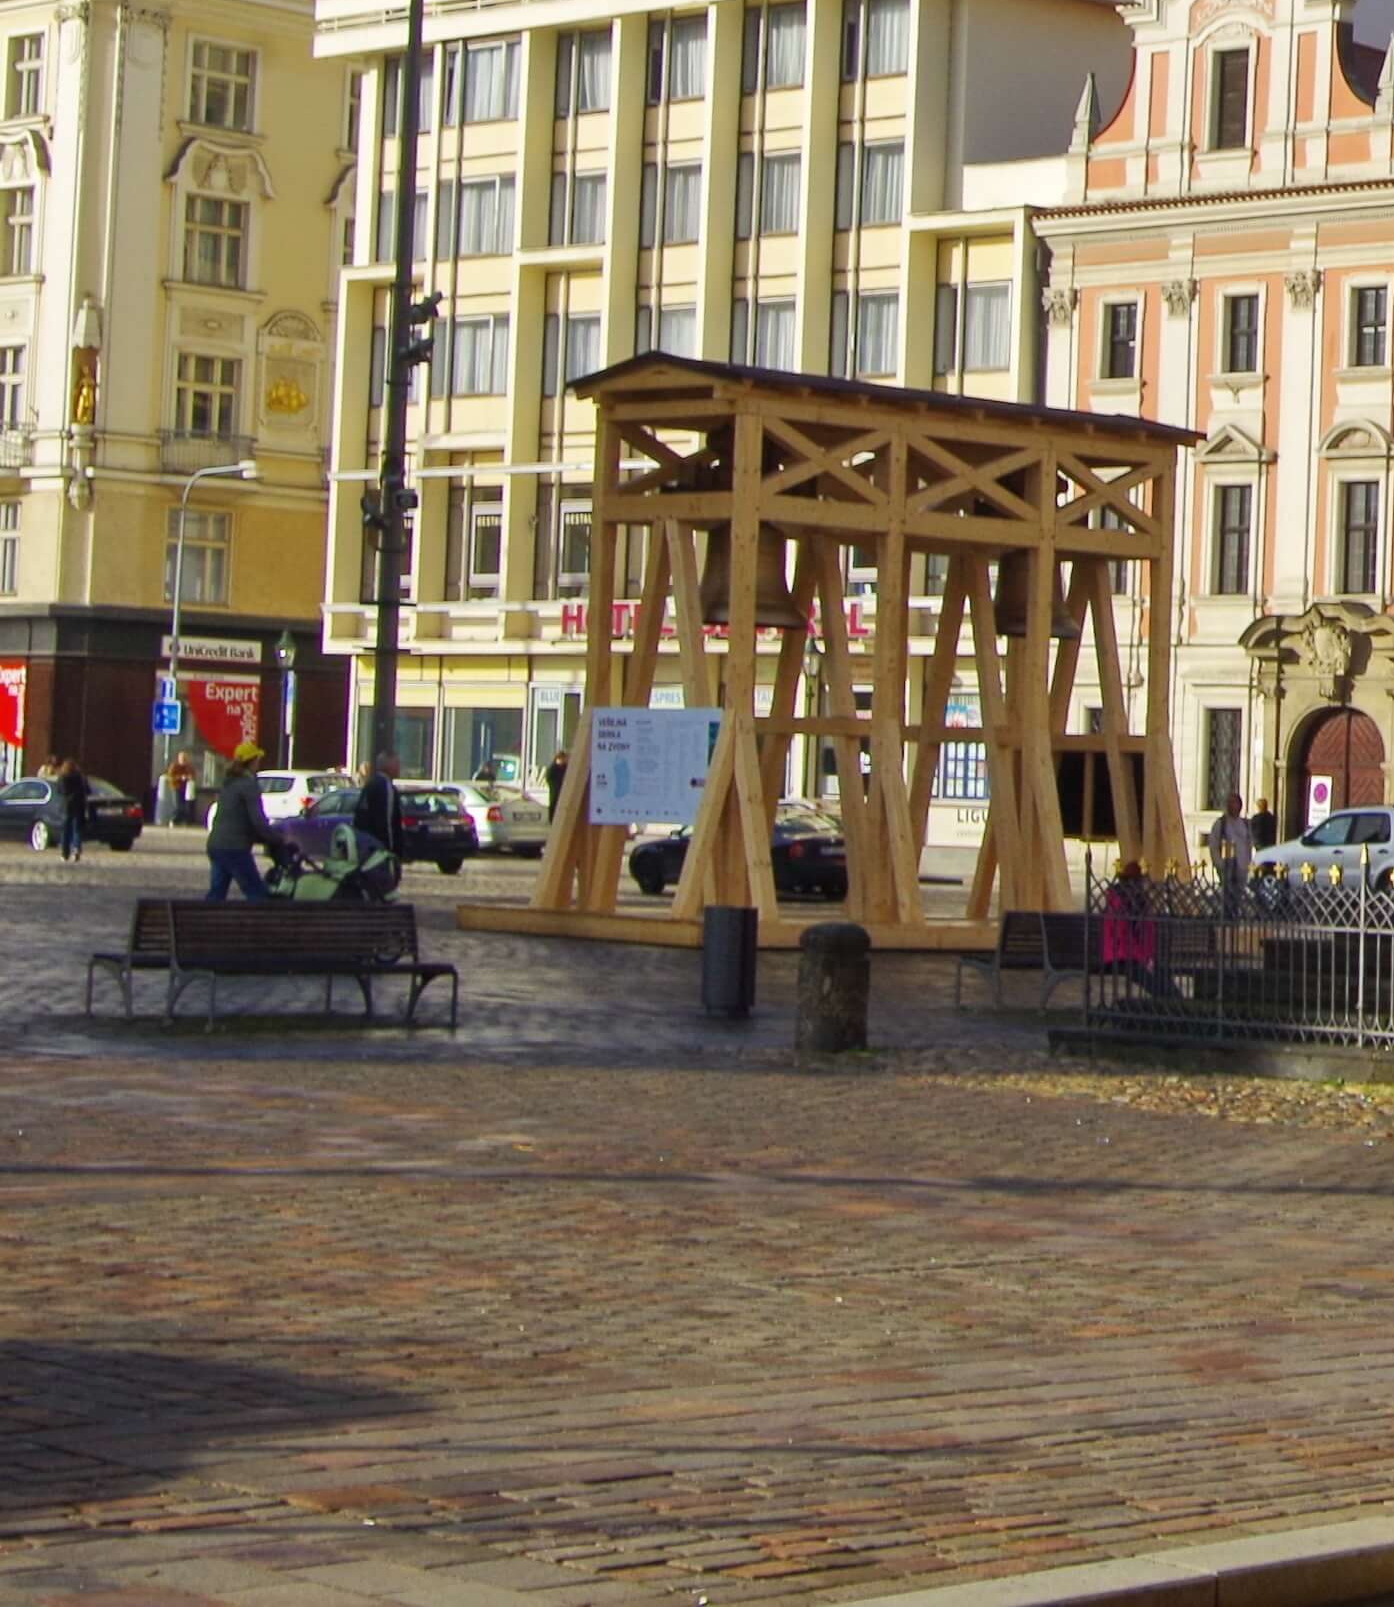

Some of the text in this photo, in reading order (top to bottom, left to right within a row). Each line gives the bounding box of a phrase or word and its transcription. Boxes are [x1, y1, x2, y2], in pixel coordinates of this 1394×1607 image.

[184, 644, 254, 659] UniCredit Bank
[206, 683, 258, 704] Expert
